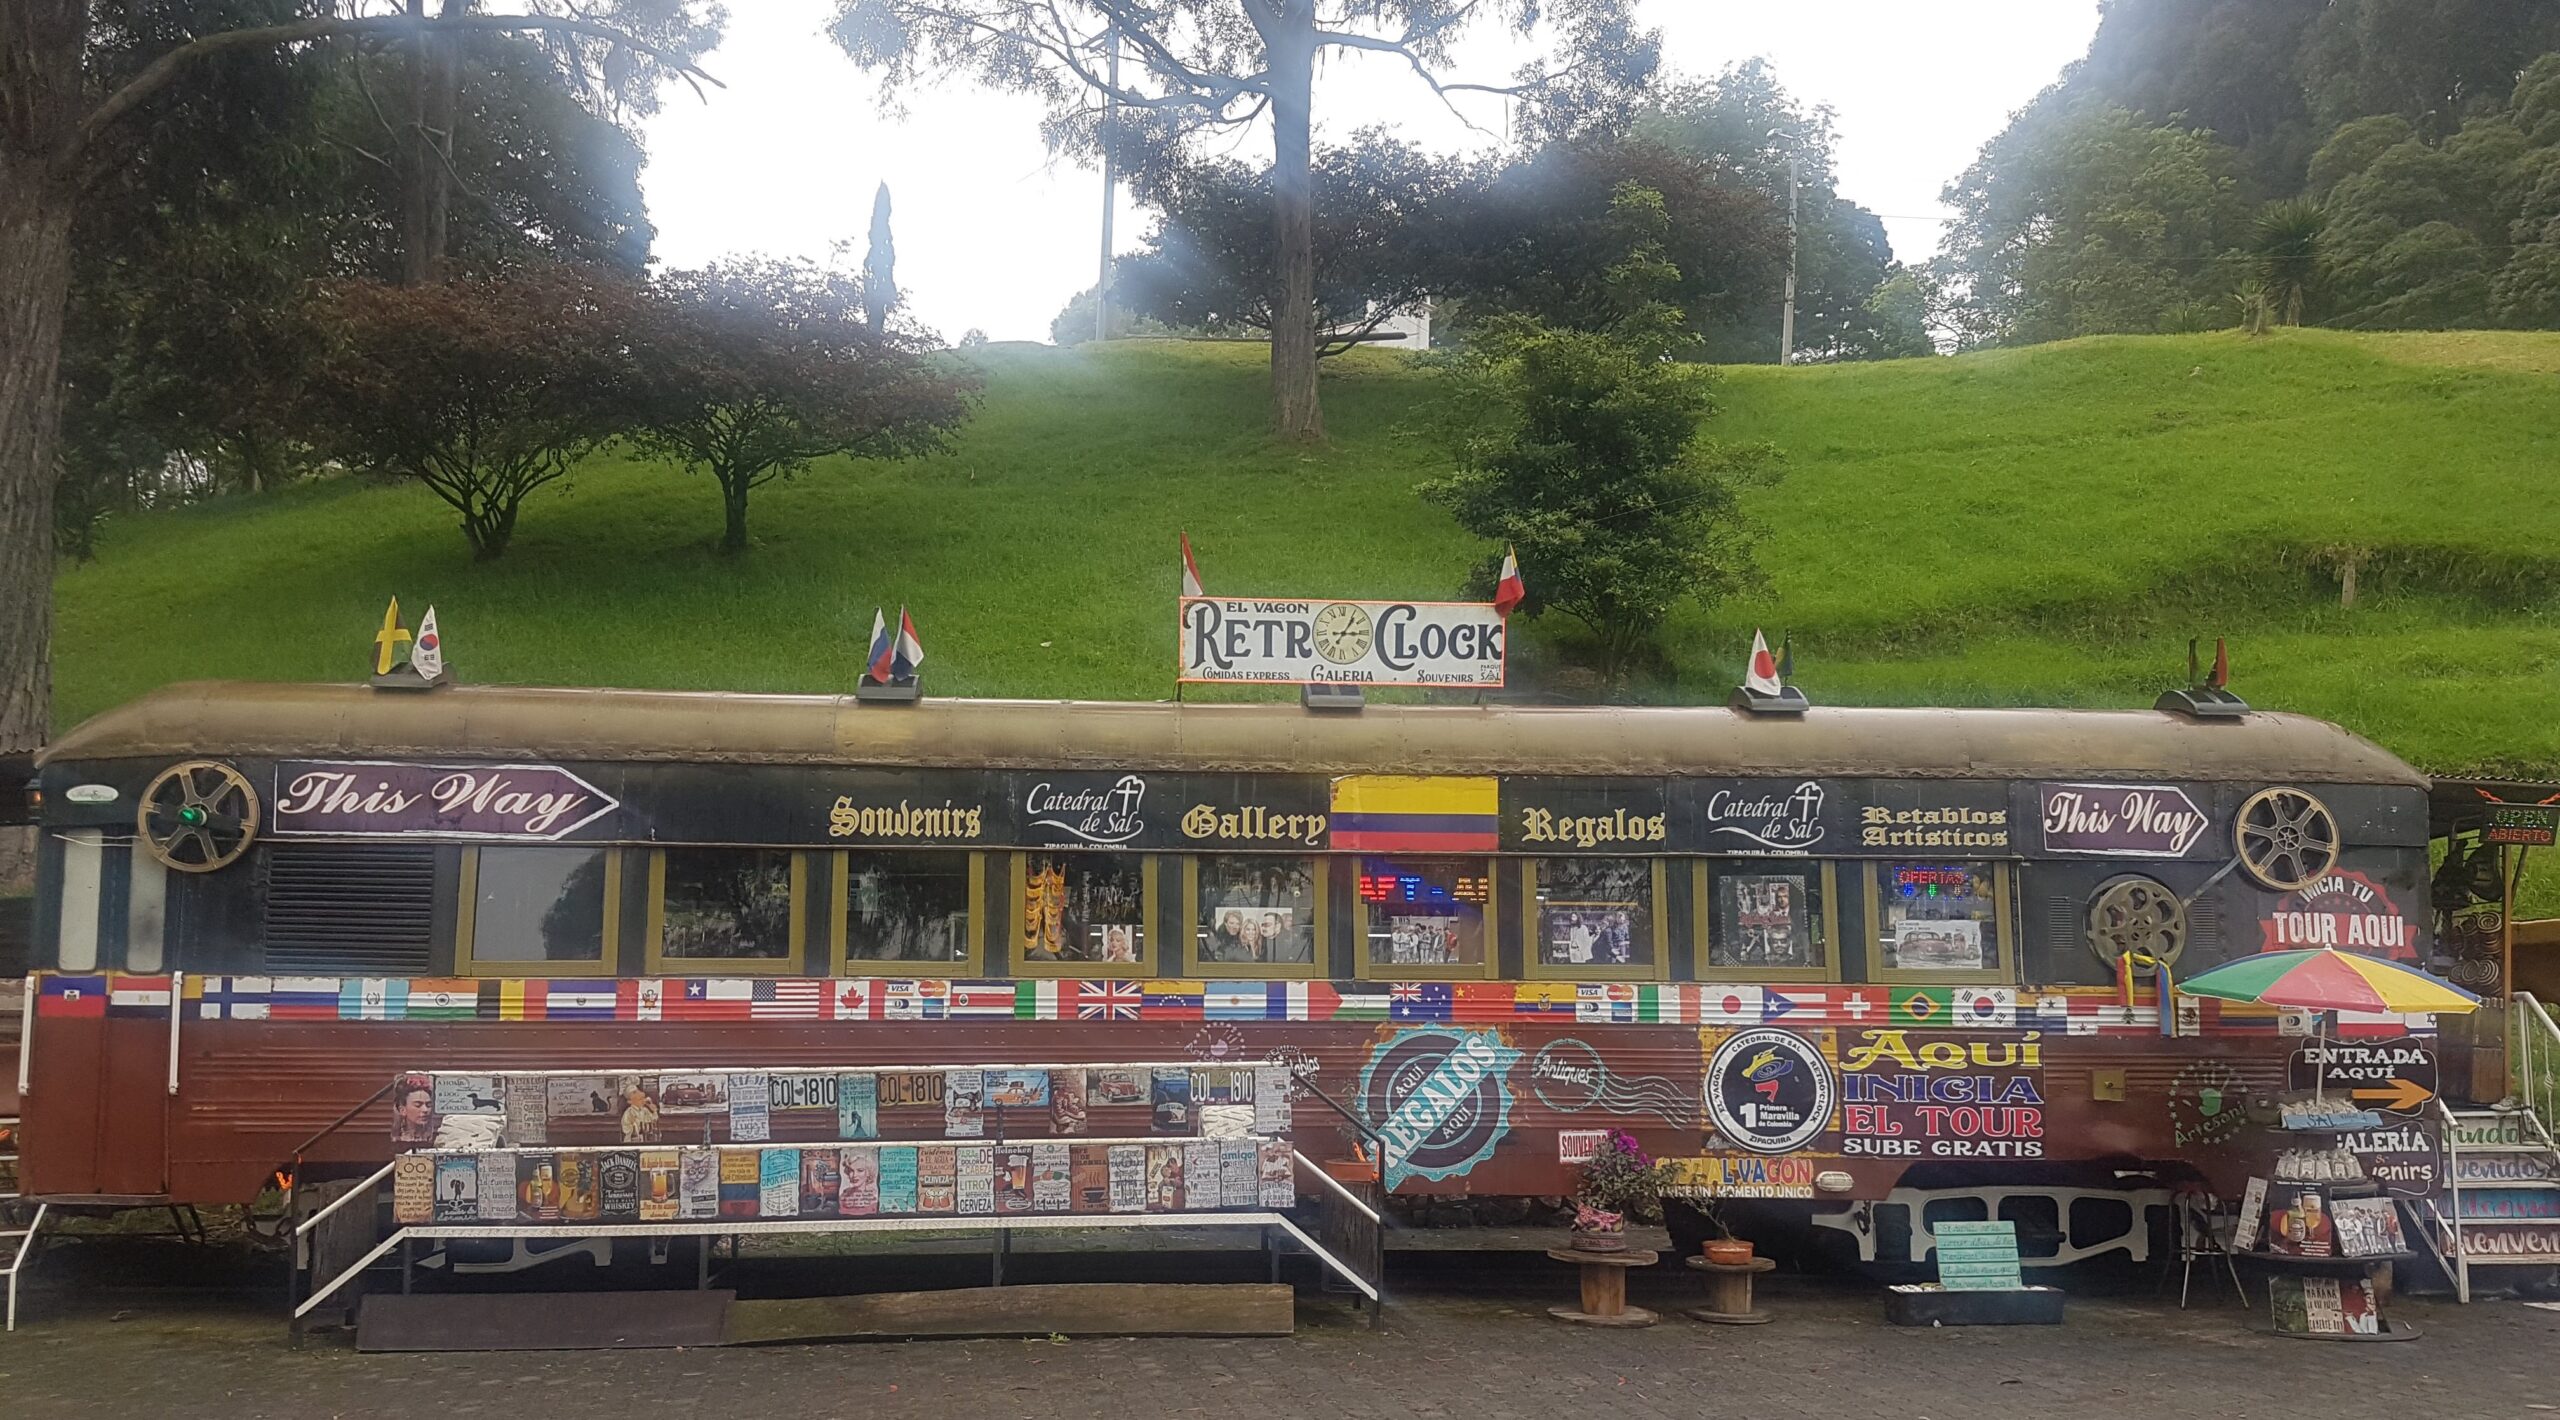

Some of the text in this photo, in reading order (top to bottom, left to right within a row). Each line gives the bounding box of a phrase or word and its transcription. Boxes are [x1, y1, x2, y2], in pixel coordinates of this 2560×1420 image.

[1226, 602, 1309, 614] EL VAGON
[1375, 604, 1502, 672] CLOCK
[1202, 664, 1474, 684] COMIDAS EXPRESS GALERIA SOUVENIRS
[278, 771, 588, 833] This Way
[1026, 783, 1117, 815] Catedral
[1707, 790, 1797, 821] Catedral
[1080, 811, 1133, 834] de Sal
[1181, 804, 1326, 846] Gallery
[1862, 806, 2007, 825] Retablos
[2045, 791, 2199, 852] This Way
[2496, 809, 2549, 825] OPEN
[1521, 807, 1665, 848] Regalos
[1760, 818, 1812, 839] de Sal
[2488, 828, 2551, 842] ABIERTO
[1900, 871, 1965, 884] OFERTAS
[2298, 876, 2374, 903] INICIA TU
[2272, 912, 2405, 947] TOUR AQUI
[1732, 1035, 1802, 1053] CATEDRAL DE SAL
[1839, 1029, 2043, 1071] AQUÍ
[2304, 1048, 2428, 1065] ENTRADA
[1538, 1055, 1592, 1086] Antiques
[2327, 1065, 2395, 1080] AQUÍ
[771, 1079, 800, 1106] COL
[801, 1078, 837, 1106] 1810
[880, 1076, 907, 1102] COL
[910, 1075, 943, 1102] 1810
[1190, 1072, 1215, 1102] COL
[1230, 1071, 1253, 1102] 1810
[1843, 1074, 2044, 1104] INICIA
[1379, 1036, 1496, 1168] REGALOS
[1740, 1103, 1757, 1128] 1
[1760, 1112, 1800, 1121] Maravilla
[1845, 1105, 2044, 1137] EL TOUR
[1749, 1135, 1792, 1145] ZIPAQUIRA
[1844, 1138, 2043, 1157] SUBE GRATIS
[601, 1159, 615, 1172] JACK
[980, 1149, 992, 1164] DE
[1222, 1151, 1257, 1161] amigos
[1707, 1158, 1735, 1185] AL
[1738, 1158, 1812, 1185] VAGON
[2372, 1161, 2432, 1180] enirs
[1222, 1182, 1257, 1192] IMPOSIBLES
[1717, 1185, 1774, 1198] MOMENTO
[1776, 1186, 1813, 1199] UNICO
[604, 1202, 635, 1210] WHISKEY
[960, 1199, 992, 1212] CERVEZA
[2306, 1288, 2337, 1299] MAÑANA
